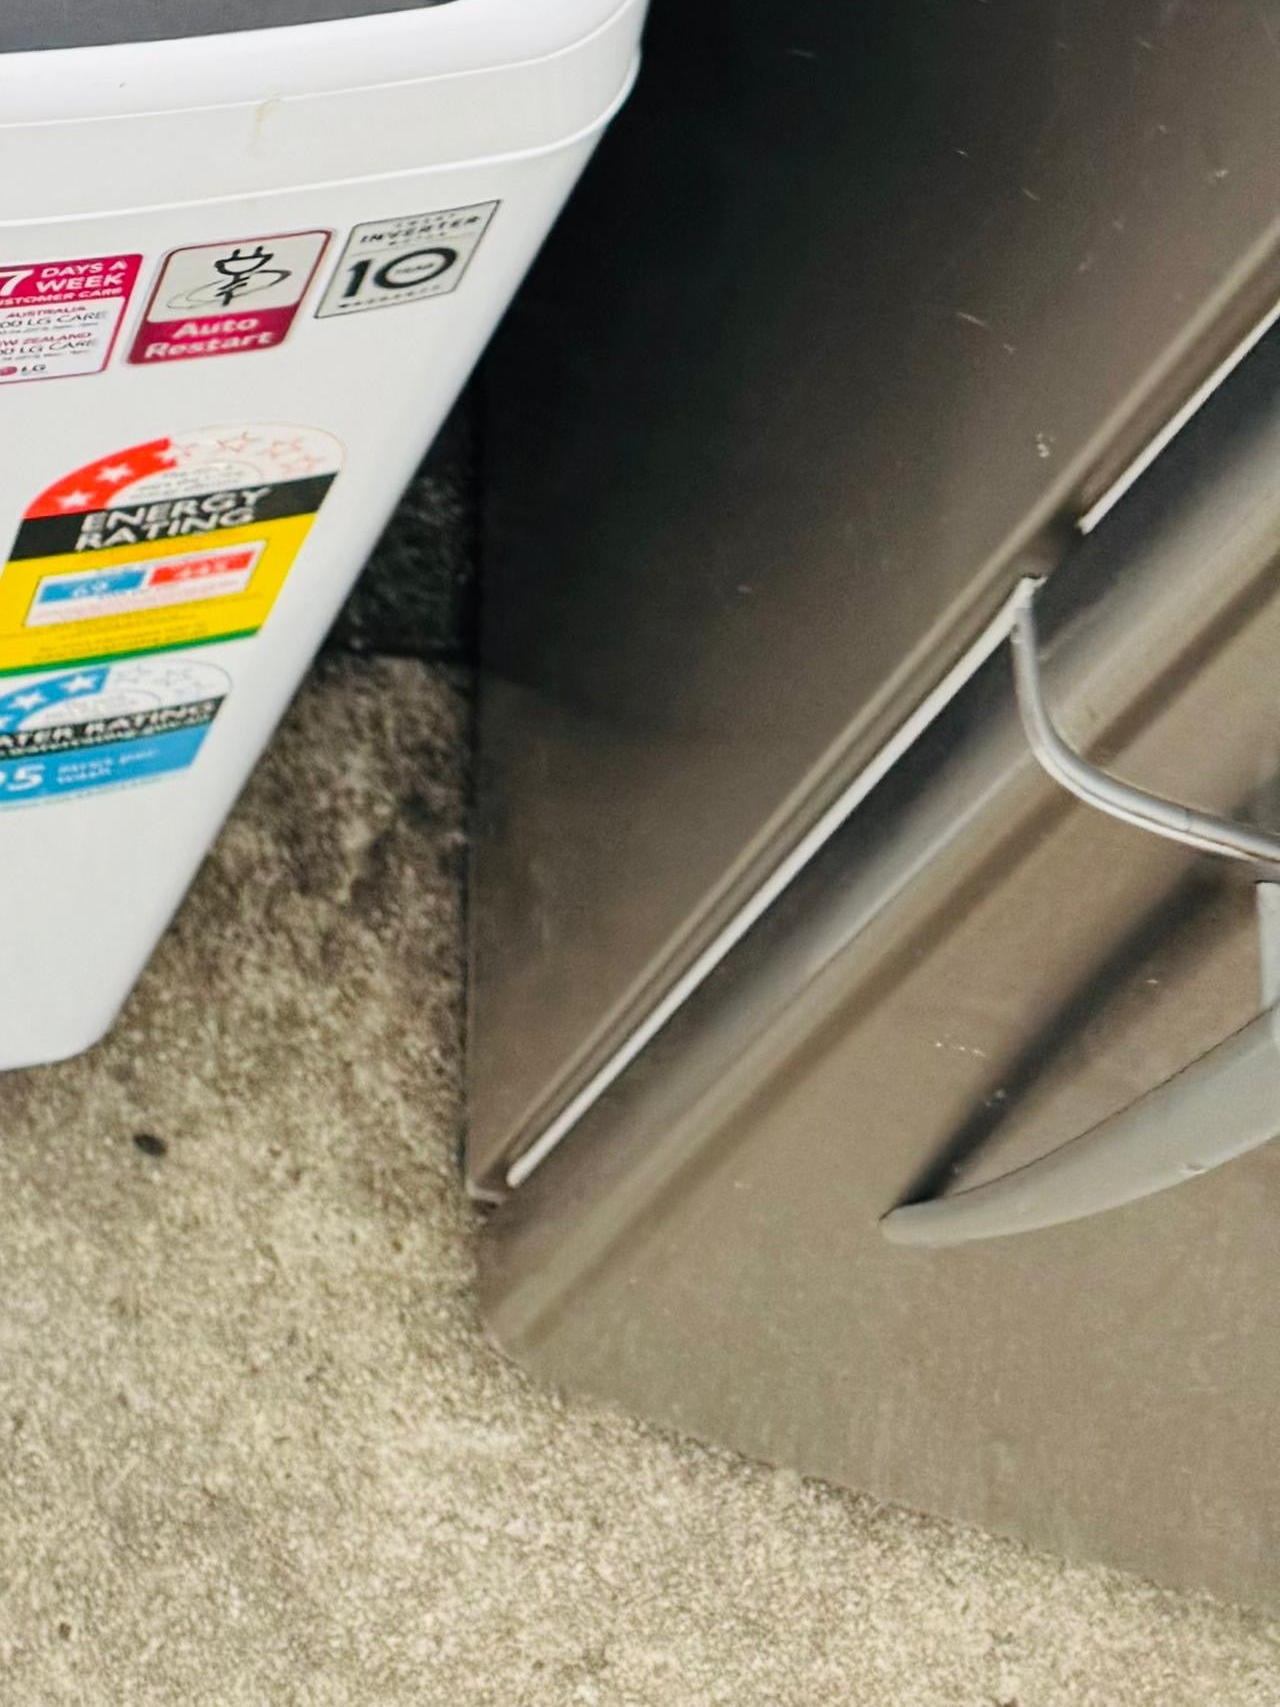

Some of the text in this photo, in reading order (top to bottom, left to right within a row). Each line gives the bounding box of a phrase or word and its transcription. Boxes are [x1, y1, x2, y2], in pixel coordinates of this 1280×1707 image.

[360, 216, 480, 243] INVERTER
[41, 259, 128, 278] DAYS A
[342, 247, 458, 298] 10
[36, 272, 123, 293] WEEK
[78, 287, 122, 298] CARE
[172, 318, 259, 339] Auto
[144, 332, 273, 358] Restart
[81, 487, 272, 533] ENERGY
[75, 508, 256, 551] RATING
[84, 702, 216, 734] RATING
